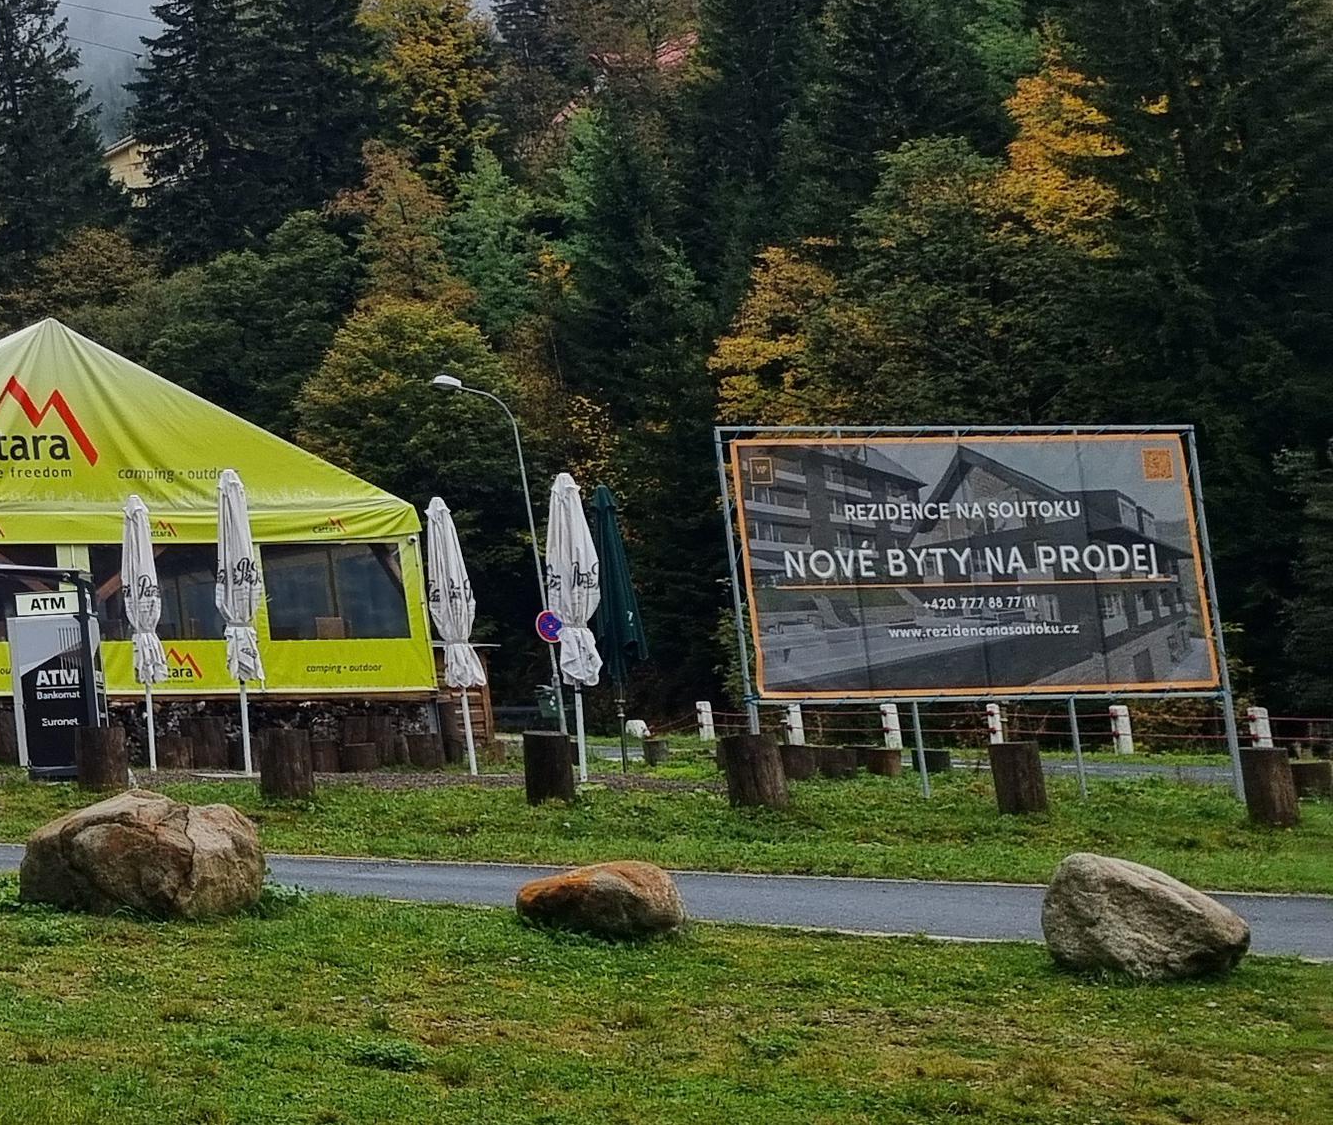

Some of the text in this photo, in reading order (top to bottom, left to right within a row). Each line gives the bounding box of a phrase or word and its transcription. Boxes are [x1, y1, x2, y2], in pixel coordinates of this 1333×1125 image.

[10, 466, 72, 478] freedom
[118, 467, 239, 483] camping outd
[844, 500, 1081, 521] REZIDENCE NA SOUTOKU
[783, 539, 1159, 579] NOVÉ BYTY NA PRODEJ
[30, 596, 66, 611] ATM
[922, 595, 1036, 610] +420 777 88 77 11
[888, 623, 1080, 638] www.rezidencenasoutoku.cz
[306, 663, 382, 675] camping outdoor
[36, 669, 80, 687] ATM
[36, 690, 81, 701] Bankomat
[41, 717, 79, 727] Euronet
